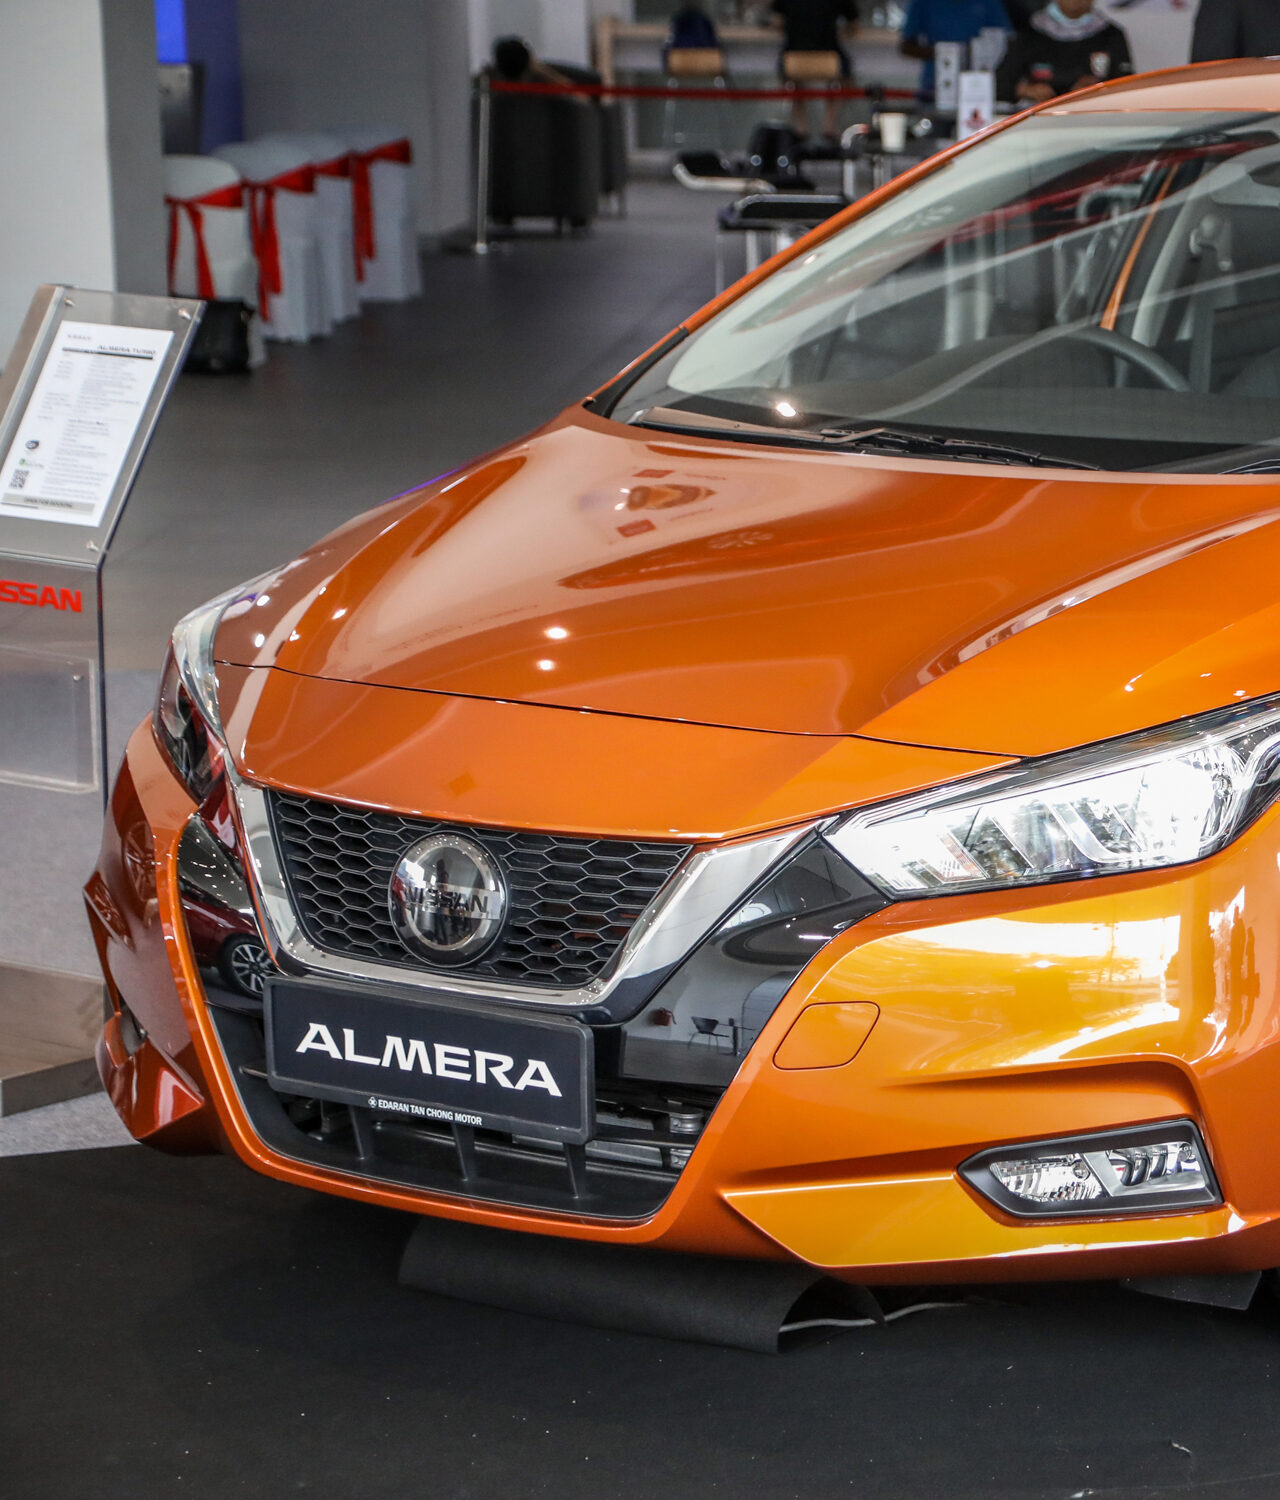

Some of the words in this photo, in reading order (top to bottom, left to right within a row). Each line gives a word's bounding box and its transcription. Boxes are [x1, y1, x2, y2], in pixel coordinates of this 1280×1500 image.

[296, 1022, 562, 1097] ALMERA
[378, 1099, 410, 1113] EDARAN
[410, 1104, 426, 1116] TAN
[426, 1107, 454, 1121] CHONG
[454, 1112, 483, 1126] MOTOR
